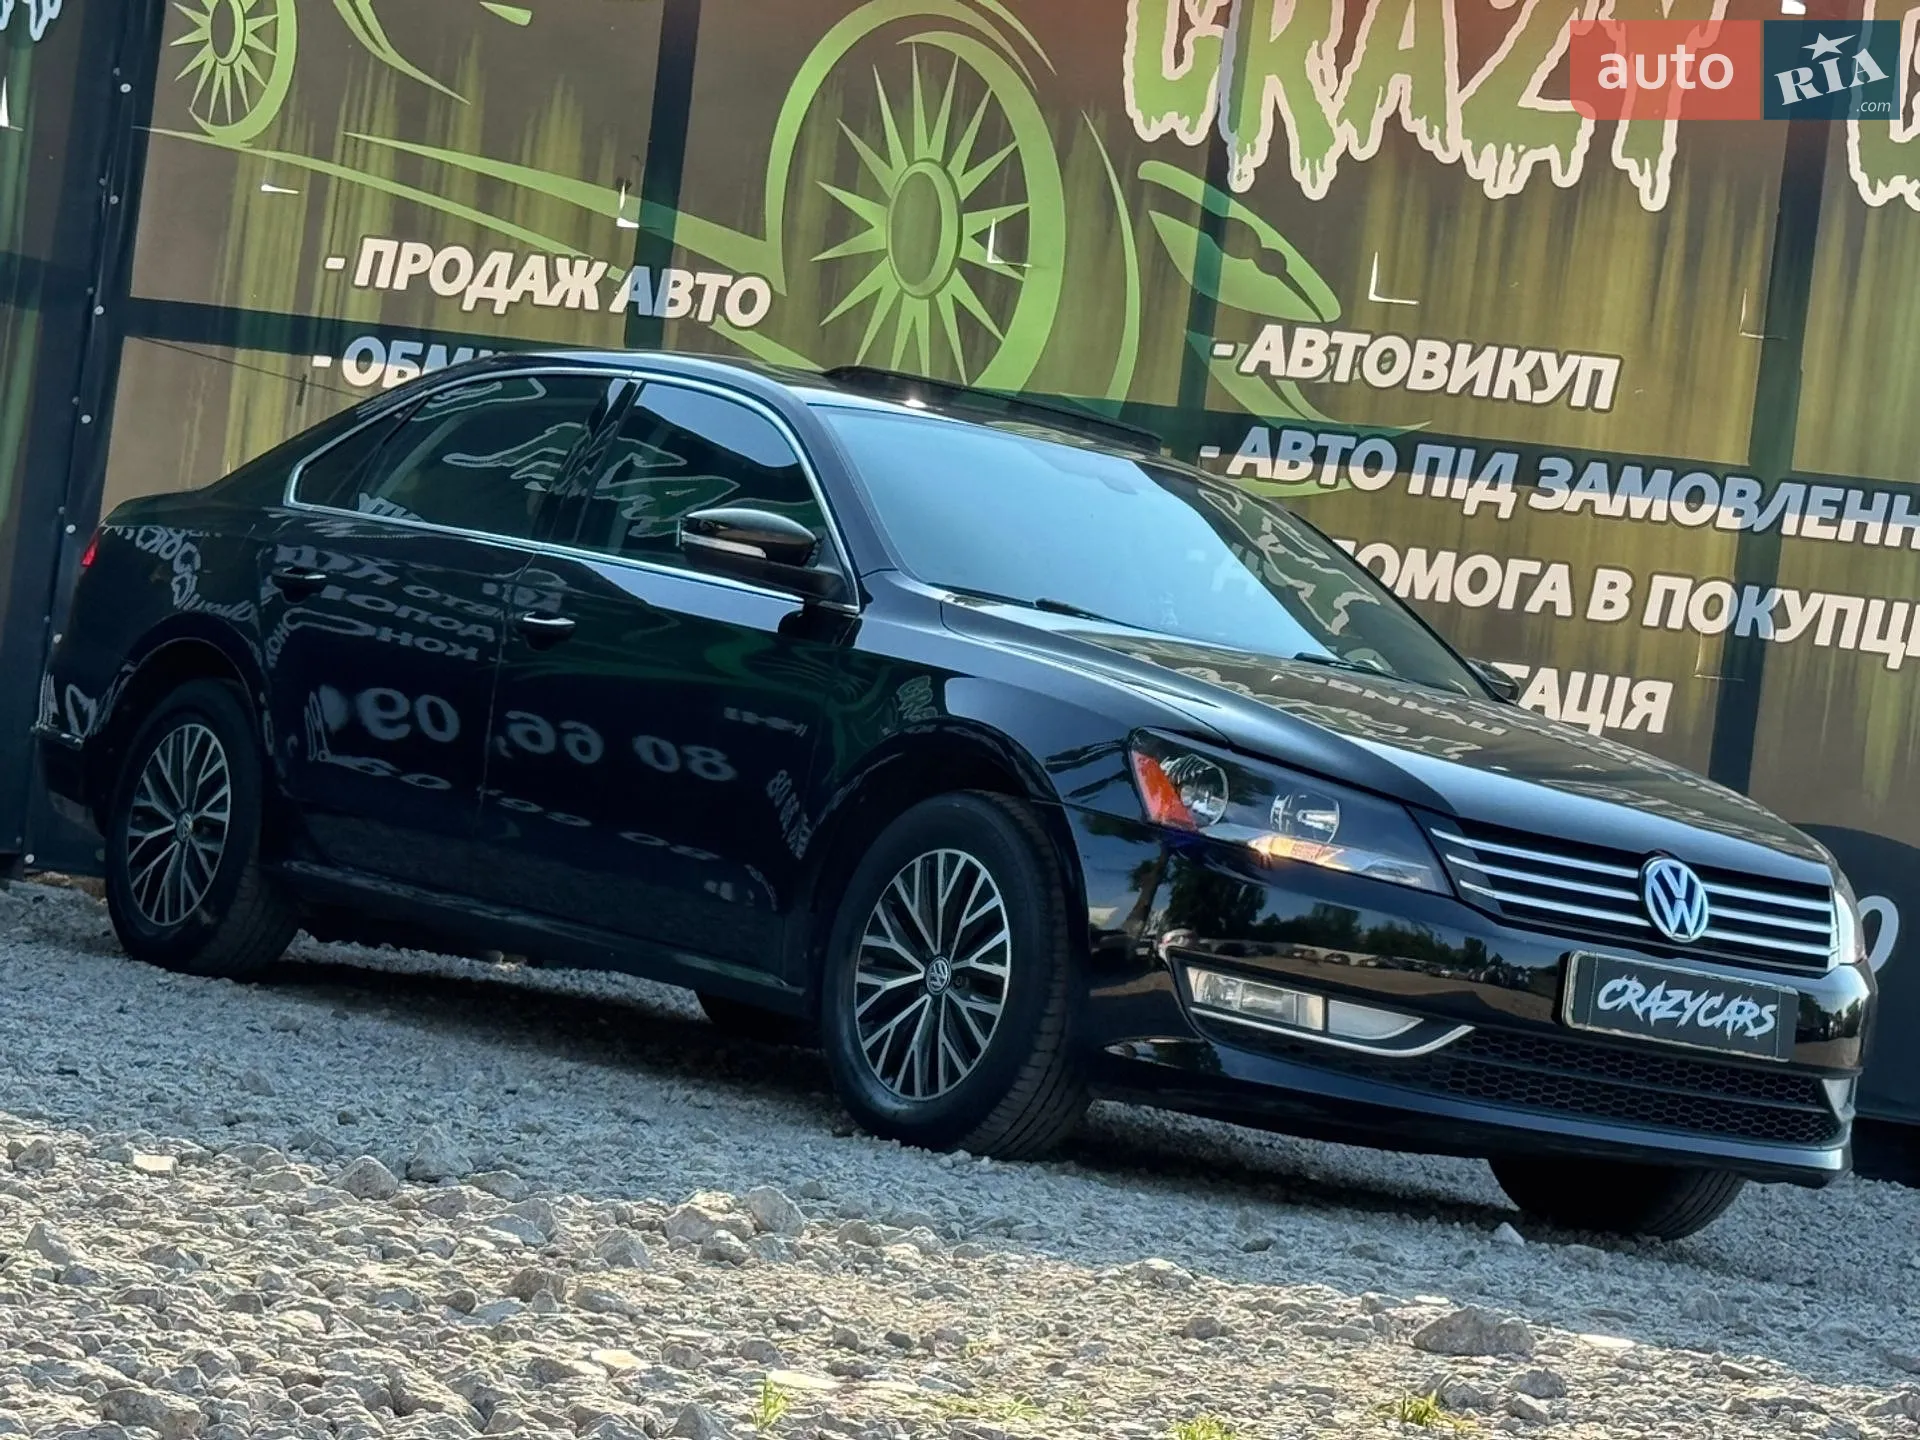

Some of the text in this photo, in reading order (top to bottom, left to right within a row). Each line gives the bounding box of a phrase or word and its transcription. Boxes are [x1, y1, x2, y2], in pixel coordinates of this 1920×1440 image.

[353, 237, 608, 314] ПРОДАЖ
[609, 265, 772, 327] АВТО
[1239, 324, 1622, 410] АВТОВИКУП
[1226, 426, 1398, 491] АВТО
[1407, 444, 1519, 518] ПІД
[1332, 539, 1573, 616] ОМОГА
[1586, 567, 1631, 622] В
[1597, 973, 1778, 1041] CRAZYCARS
